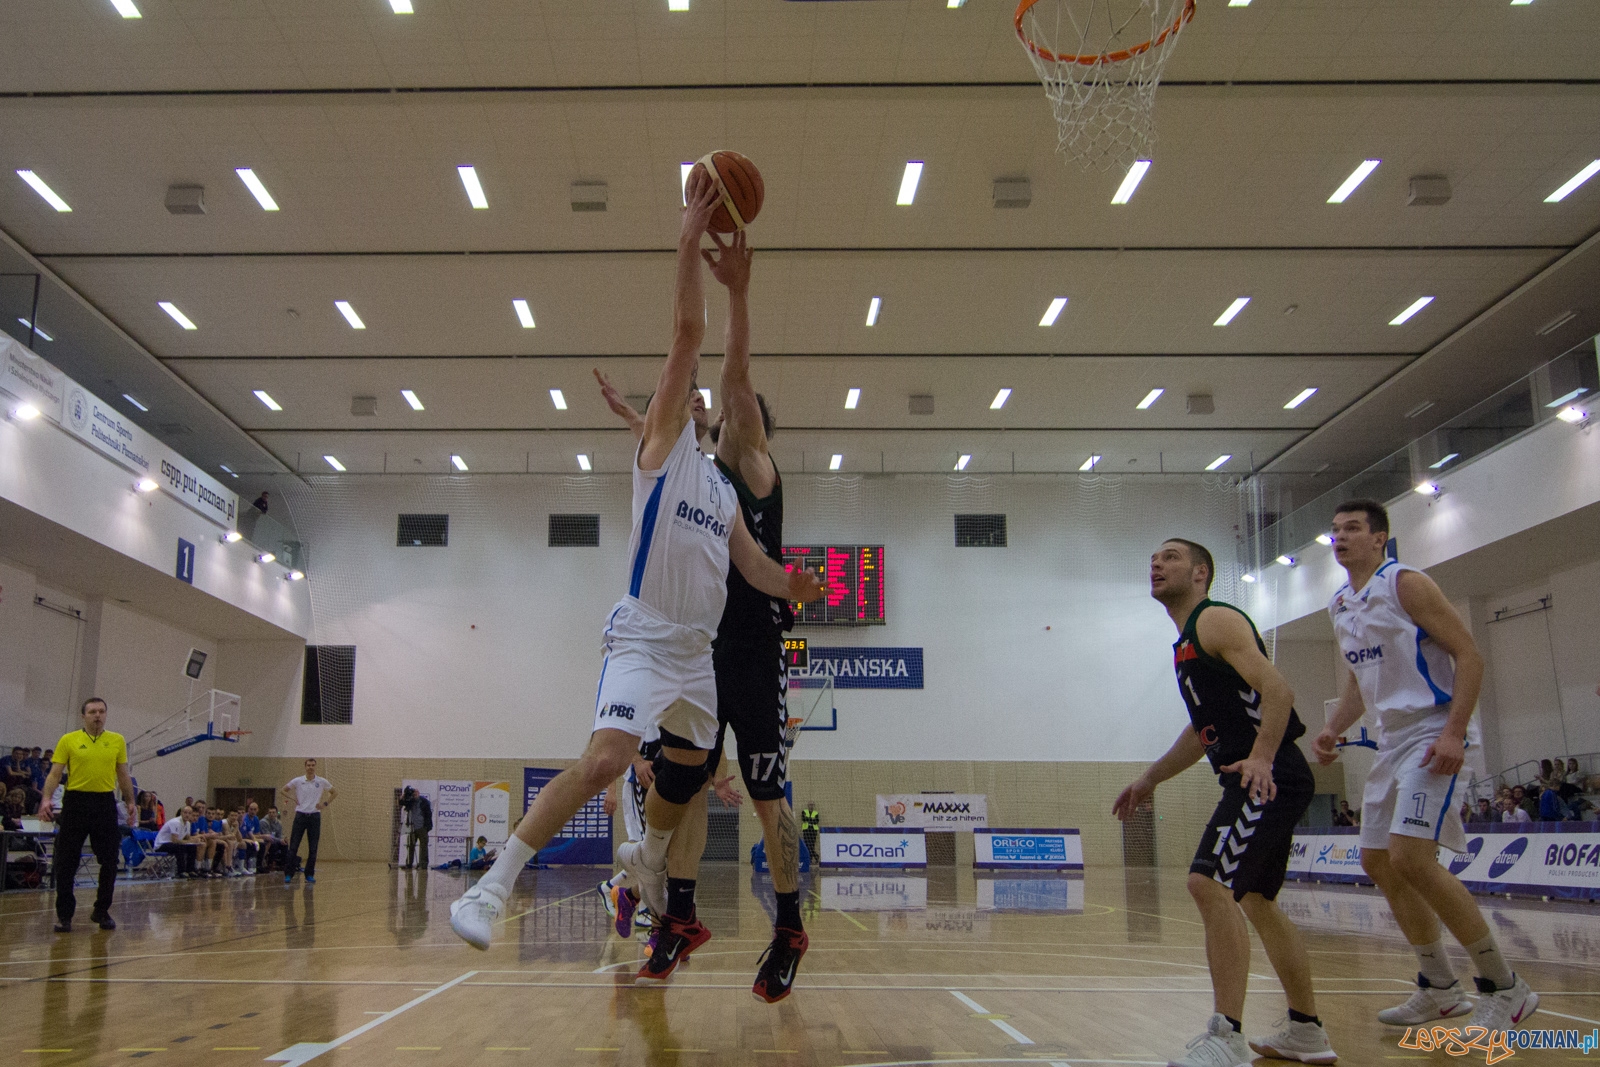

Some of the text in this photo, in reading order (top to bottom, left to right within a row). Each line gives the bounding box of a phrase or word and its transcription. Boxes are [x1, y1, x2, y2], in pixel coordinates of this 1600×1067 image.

[91, 423, 121, 452] Politechniki
[93, 405, 132, 441] Centrum Sportu
[160, 459, 235, 520] cspp.put.poznan.pl
[183, 545, 190, 578] 1
[609, 704, 635, 720] PBG
[749, 752, 779, 781] 17
[922, 802, 970, 814] MAXXX
[1412, 792, 1427, 819] 1
[1495, 850, 1519, 864] atrem
